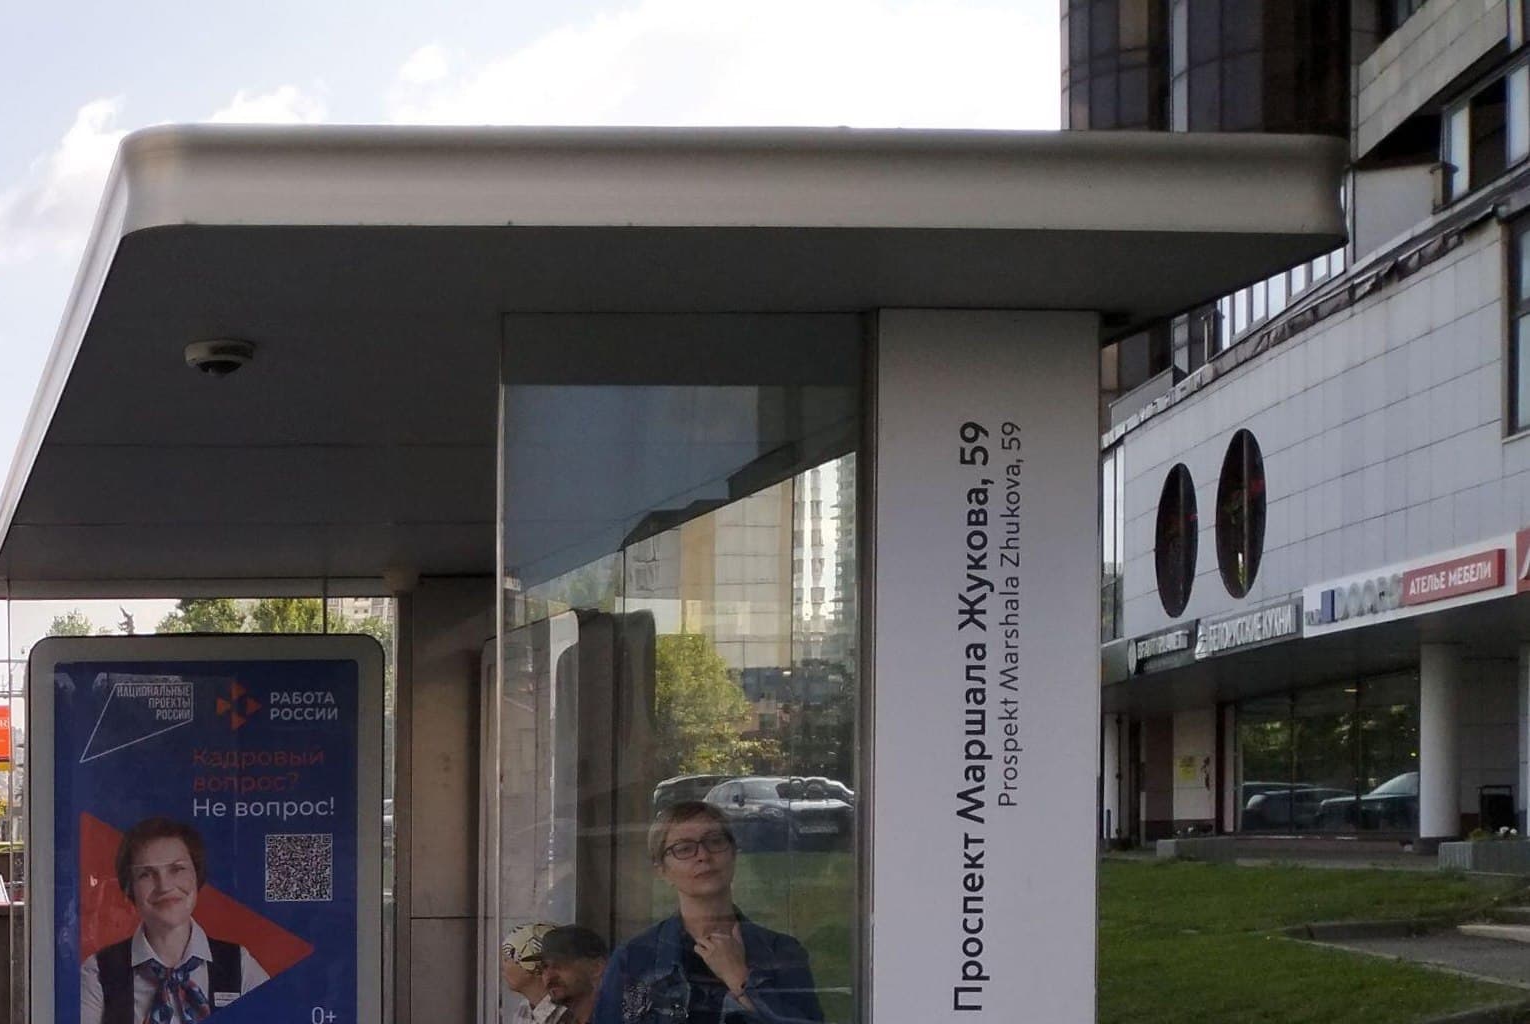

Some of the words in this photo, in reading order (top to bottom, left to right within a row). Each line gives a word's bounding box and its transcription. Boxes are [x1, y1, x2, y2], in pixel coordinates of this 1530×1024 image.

[959, 421, 991, 467] 59
[1000, 421, 1023, 451] 59
[999, 458, 1024, 567] Zhukova,
[957, 475, 996, 632] Жукова,
[1409, 573, 1446, 596] АТЕЛЬЕ
[1448, 560, 1492, 588] МЕБЕЛИ
[999, 577, 1021, 691] Marshala
[116, 685, 191, 698] НАЦИОНАЛЬНЫЕ
[148, 697, 191, 709] ПРОЕКТЫ
[270, 691, 335, 705] РАБОТА
[155, 708, 191, 720] РОССИИ
[270, 707, 339, 721] РОССИИ
[956, 643, 993, 824] Маршала
[193, 749, 326, 769] Кадровый
[998, 698, 1023, 806] Prospekt
[193, 772, 299, 794] вопрос?
[193, 798, 227, 817] Не
[235, 797, 335, 821] вопрос!
[954, 832, 993, 1012] Проспект
